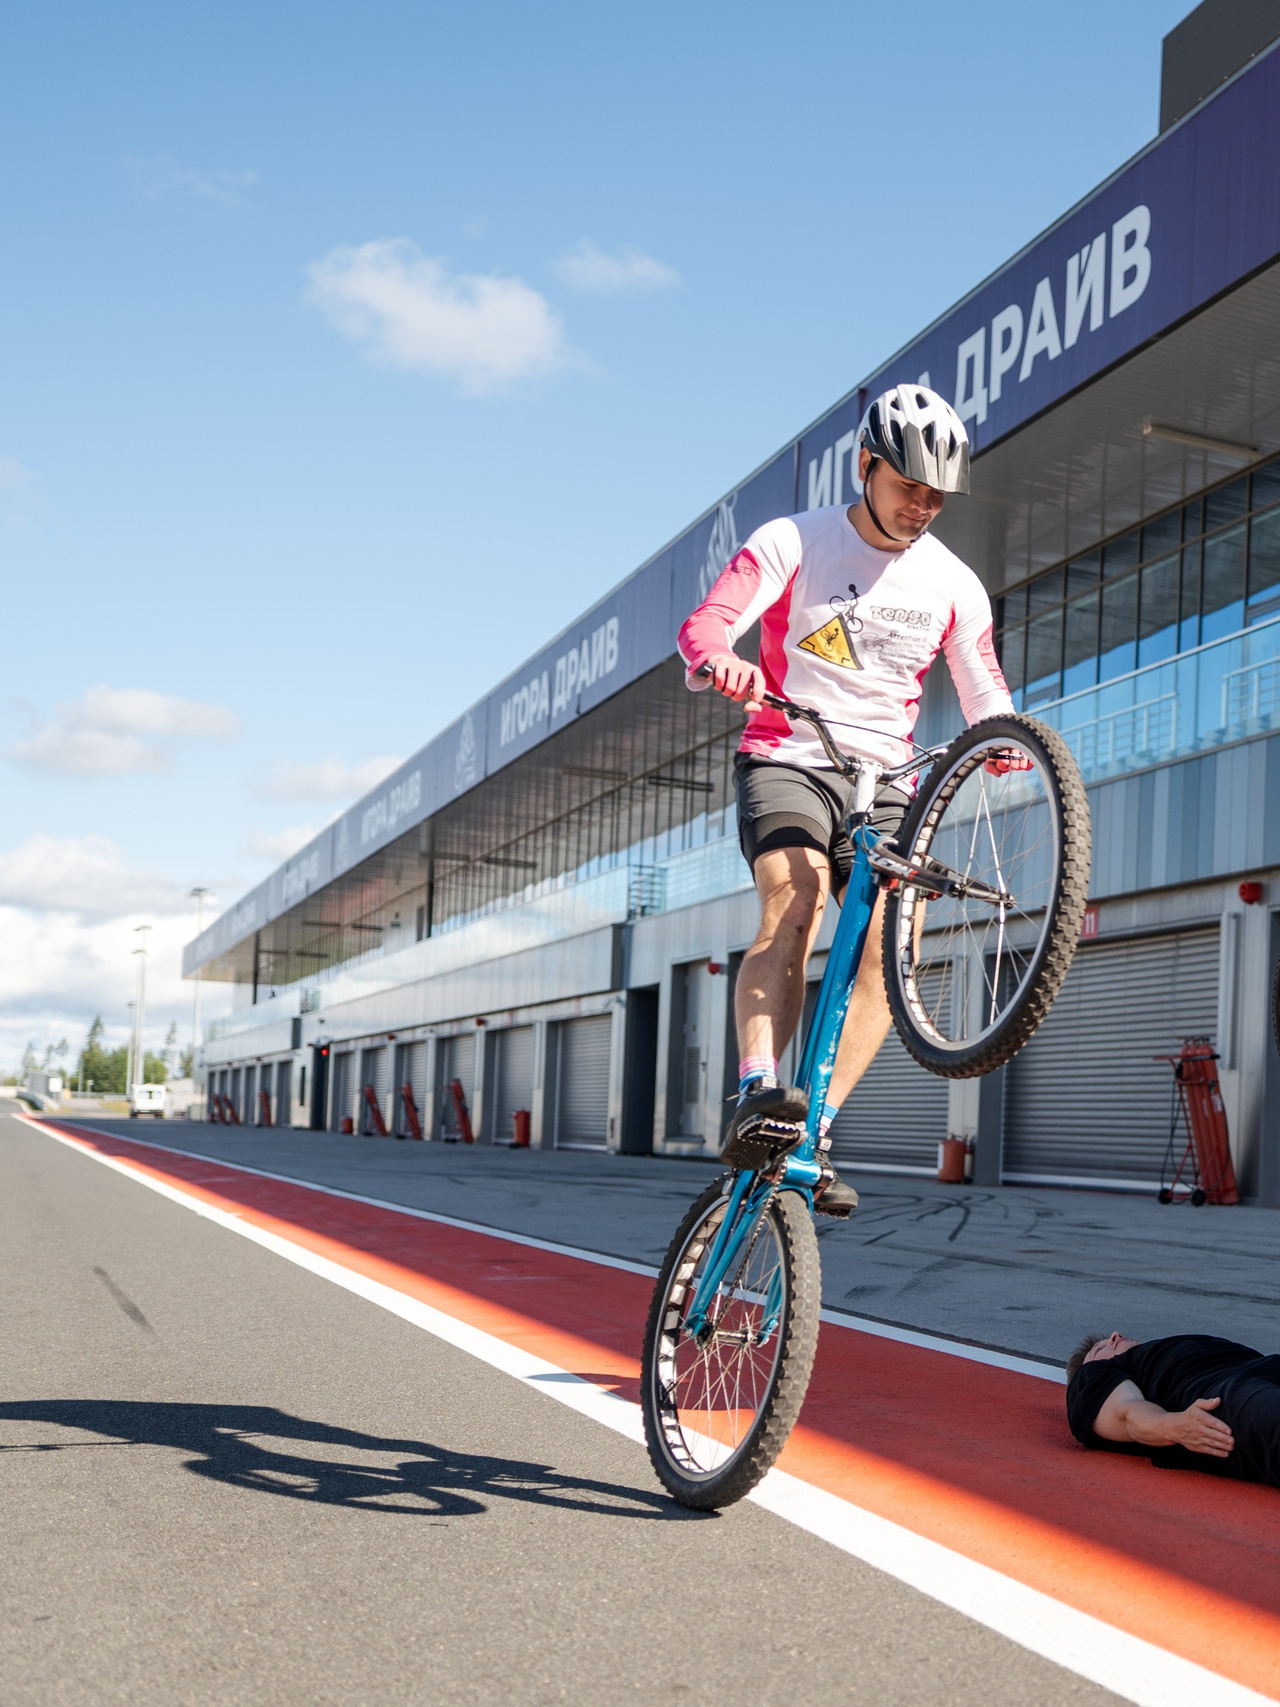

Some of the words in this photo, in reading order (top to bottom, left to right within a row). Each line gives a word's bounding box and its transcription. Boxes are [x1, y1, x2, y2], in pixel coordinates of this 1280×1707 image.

[953, 204, 1152, 427] ДРАЙВ
[500, 669, 550, 747] ИГОРА
[1084, 911, 1096, 935] 11
